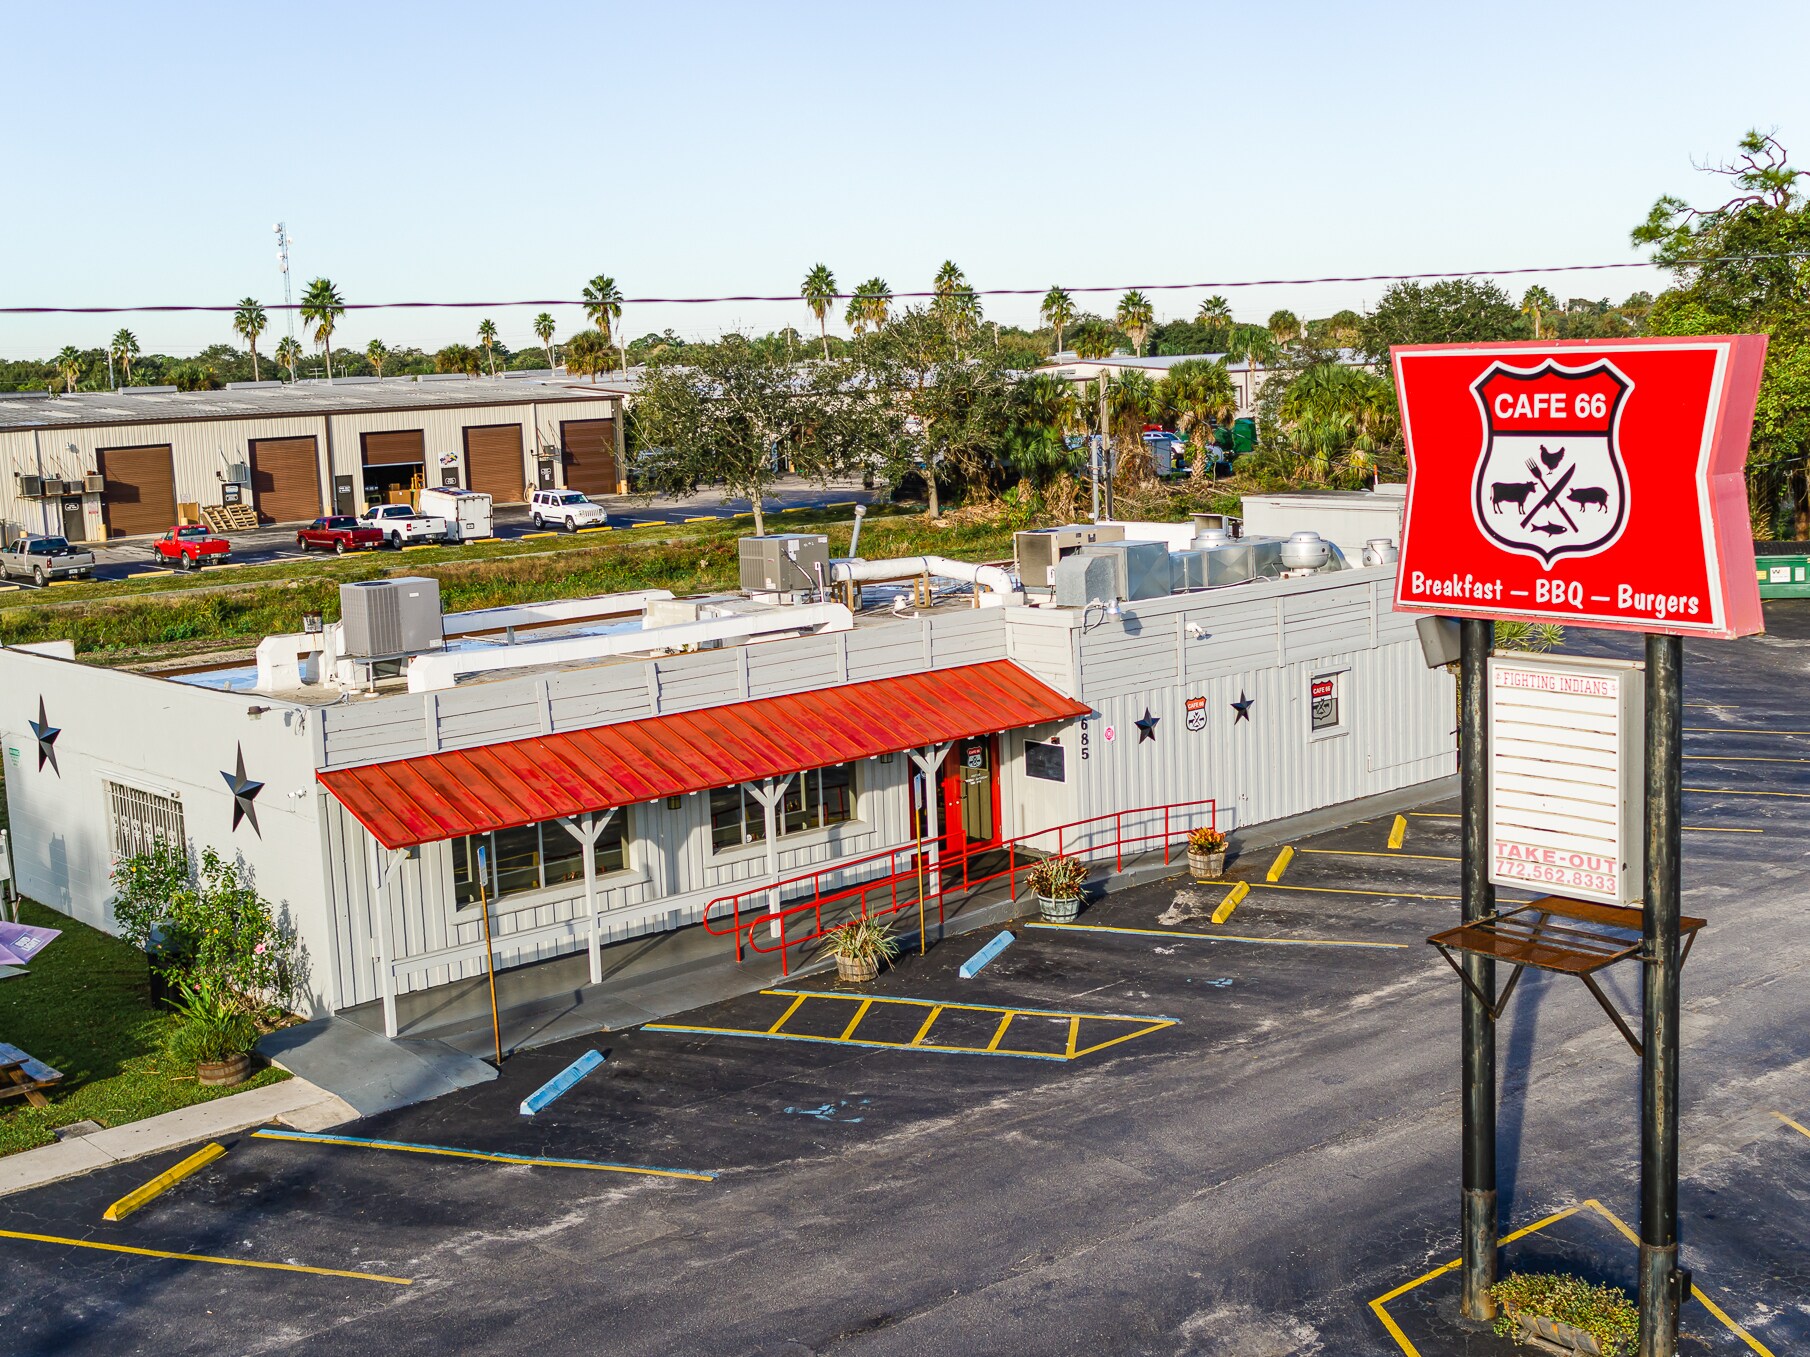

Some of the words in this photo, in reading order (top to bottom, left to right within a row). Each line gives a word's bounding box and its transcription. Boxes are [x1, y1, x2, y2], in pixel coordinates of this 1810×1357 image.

[1494, 393, 1567, 419] CAFE
[1574, 393, 1607, 419] 66
[1411, 571, 1503, 600] Breakfast
[1535, 578, 1583, 609] BBQ
[1617, 584, 1699, 619] Burgers
[1503, 672, 1556, 690] FIGHTING
[1559, 677, 1608, 696] INDIANS
[1495, 842, 1617, 873] TAKE-OUT
[1495, 860, 1616, 891] 772.562.8333
